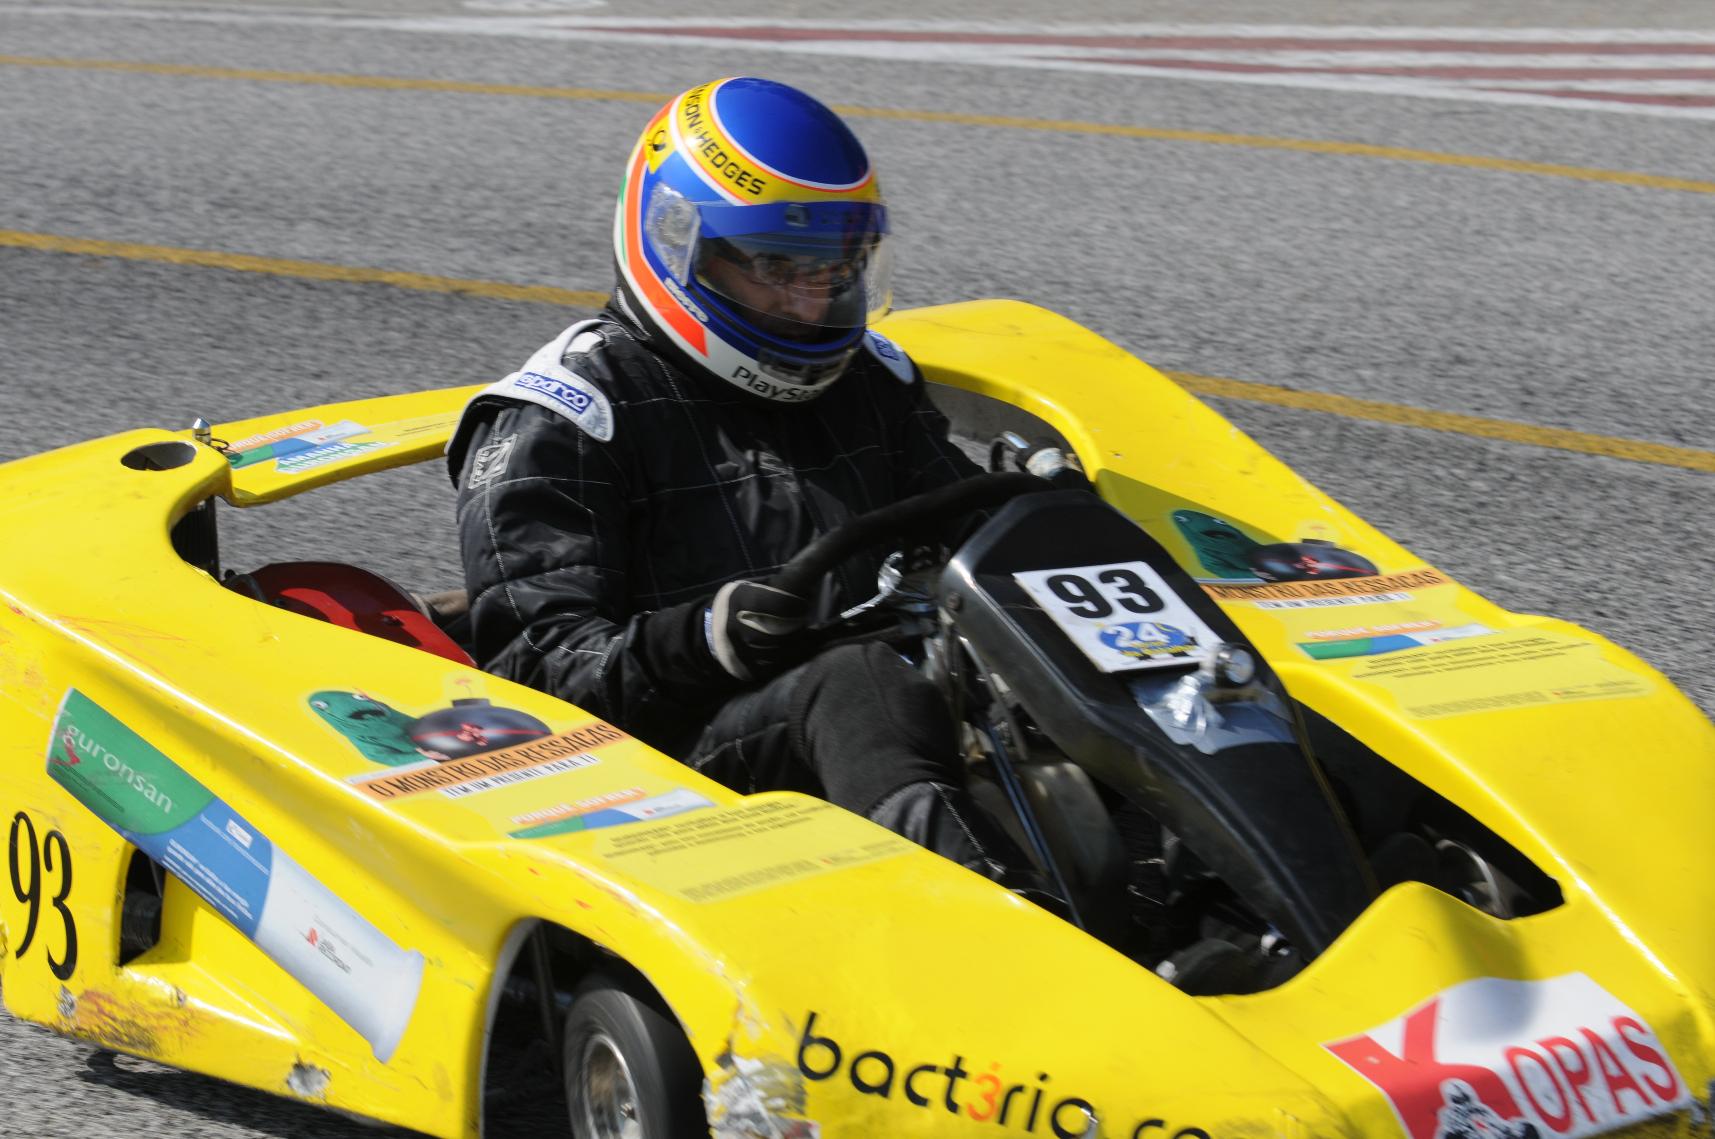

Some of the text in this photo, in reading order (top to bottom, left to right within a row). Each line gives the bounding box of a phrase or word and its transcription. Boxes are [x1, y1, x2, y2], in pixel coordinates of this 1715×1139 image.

[695, 131, 768, 196] HEDGES
[517, 374, 590, 408] sparco
[1046, 568, 1166, 619] 93
[1103, 621, 1172, 648] 24
[62, 724, 175, 814] guronsan
[367, 723, 623, 798] O MONSTRO DAS RESSACAS
[8, 811, 79, 981] 93
